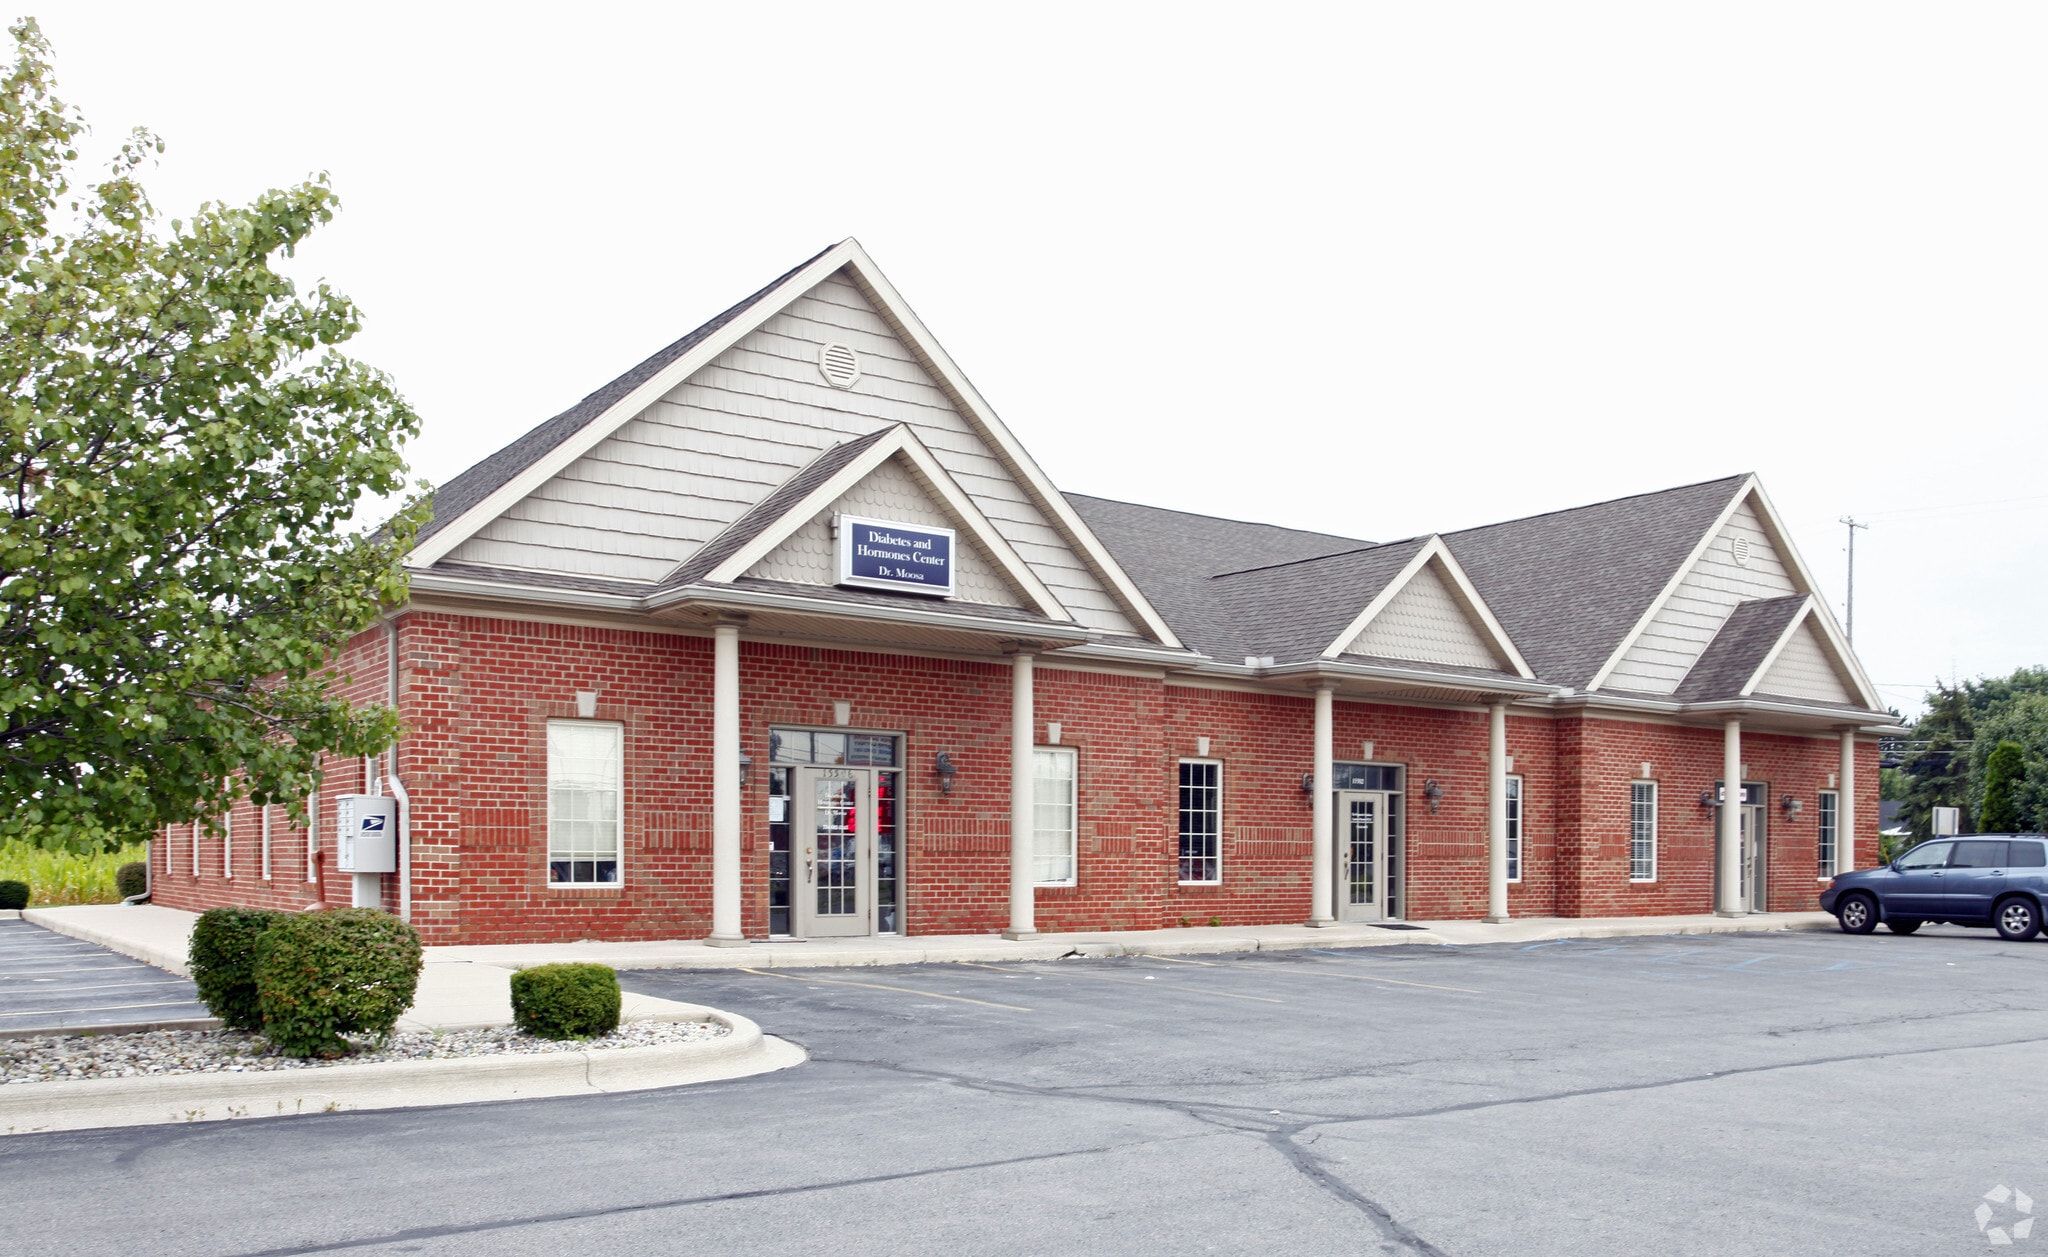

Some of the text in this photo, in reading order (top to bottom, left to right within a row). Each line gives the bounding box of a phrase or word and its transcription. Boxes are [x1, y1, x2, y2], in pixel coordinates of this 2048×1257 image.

[869, 531, 931, 550] Diabetes and
[857, 544, 945, 566] Hormones Center
[879, 566, 924, 580] Dr. Moosa
